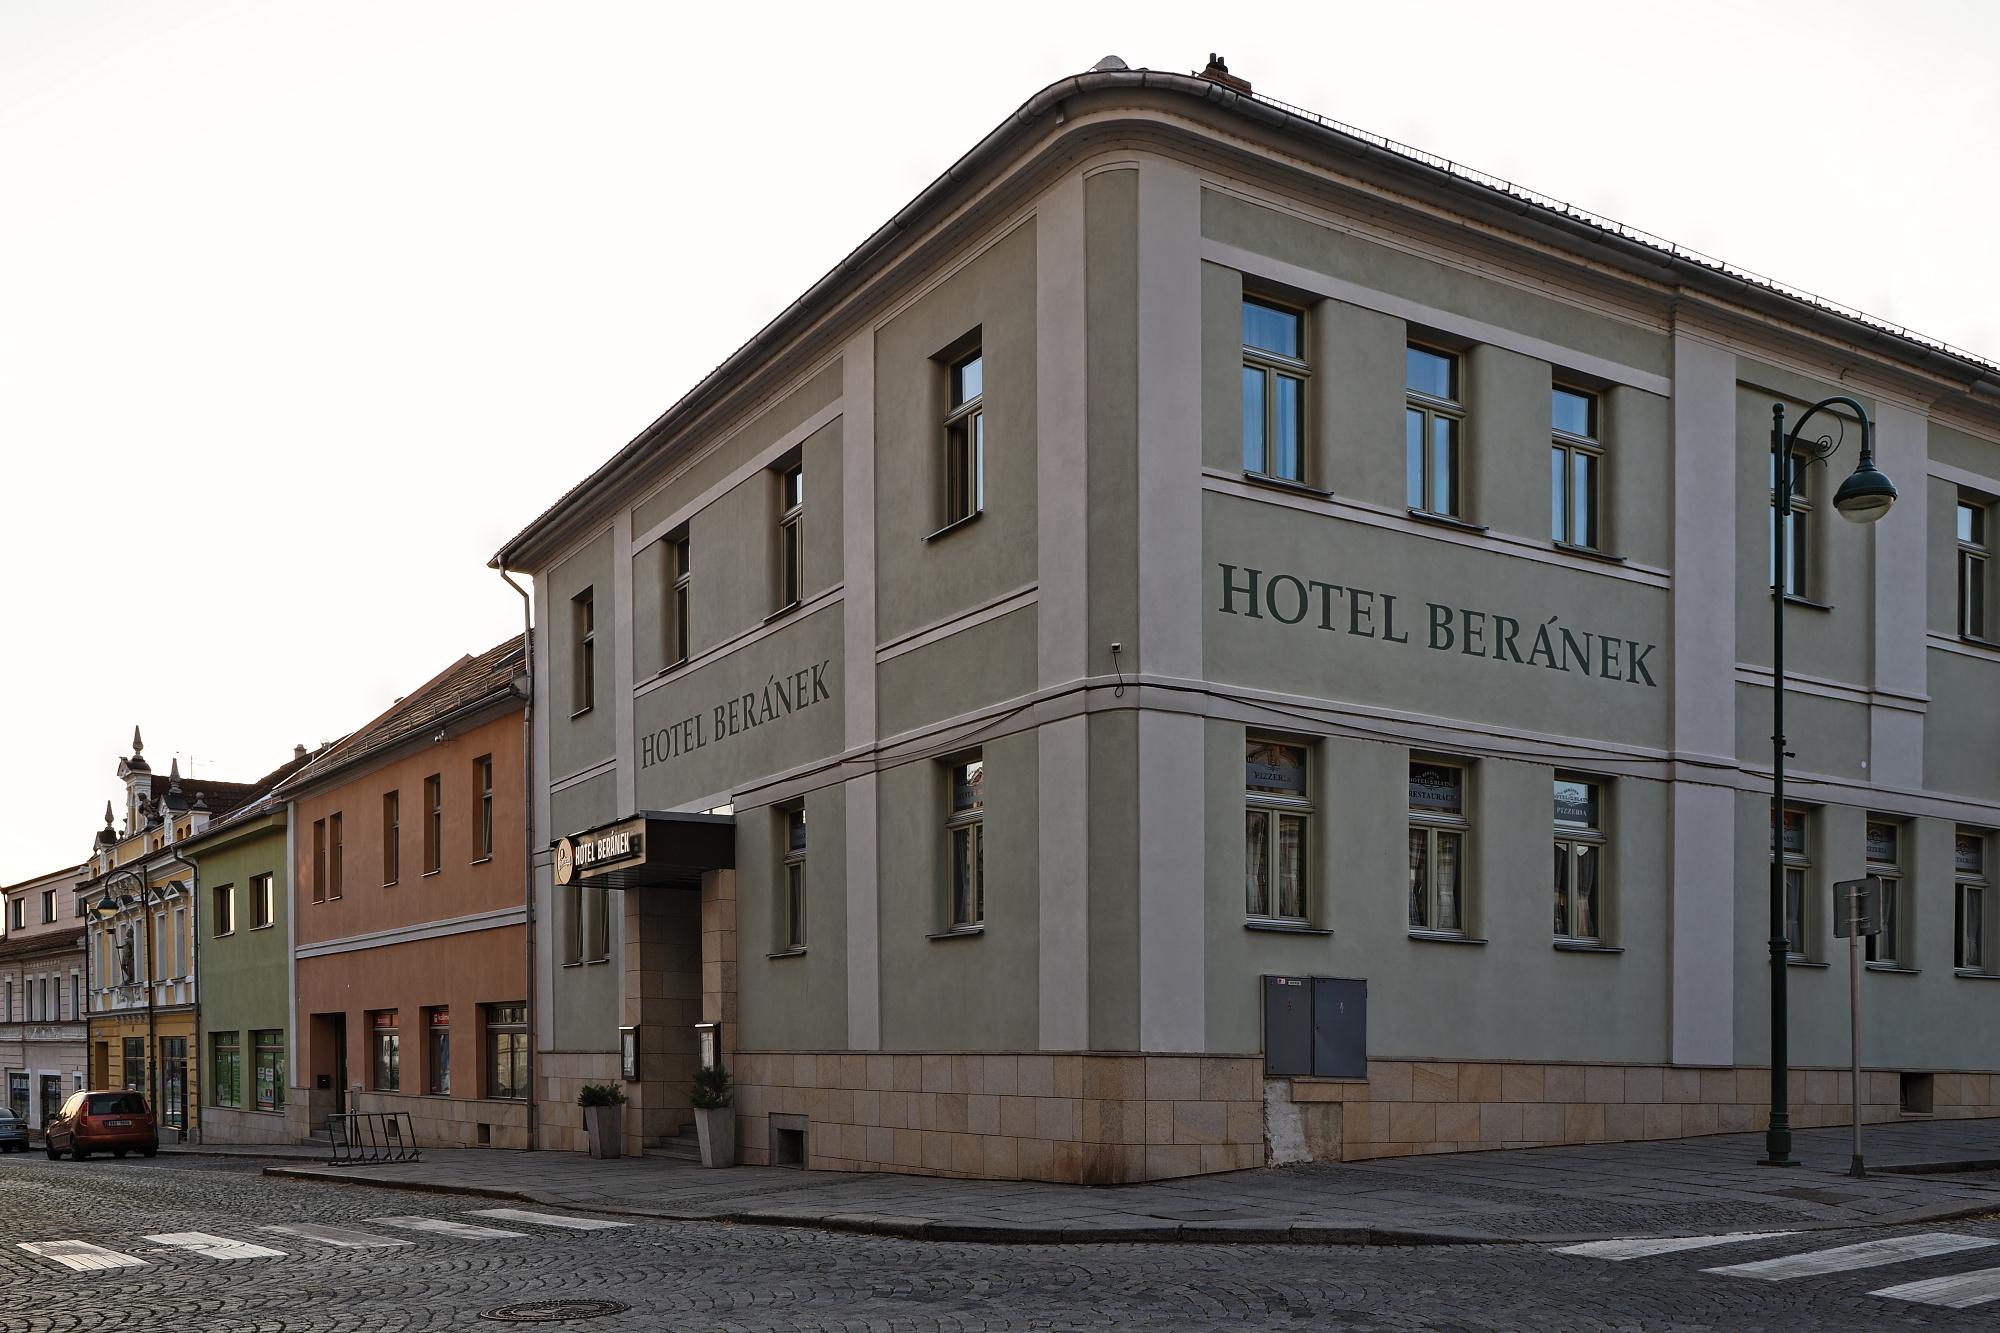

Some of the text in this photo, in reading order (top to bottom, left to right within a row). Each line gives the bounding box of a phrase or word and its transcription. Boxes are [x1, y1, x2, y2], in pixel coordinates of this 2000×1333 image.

[1218, 563, 1657, 687] HOTEL BERÁNEK
[641, 660, 830, 770] HOTEL BERÁNEK
[575, 841, 595, 866] HOTEL
[597, 830, 630, 860] BERÁNEK
